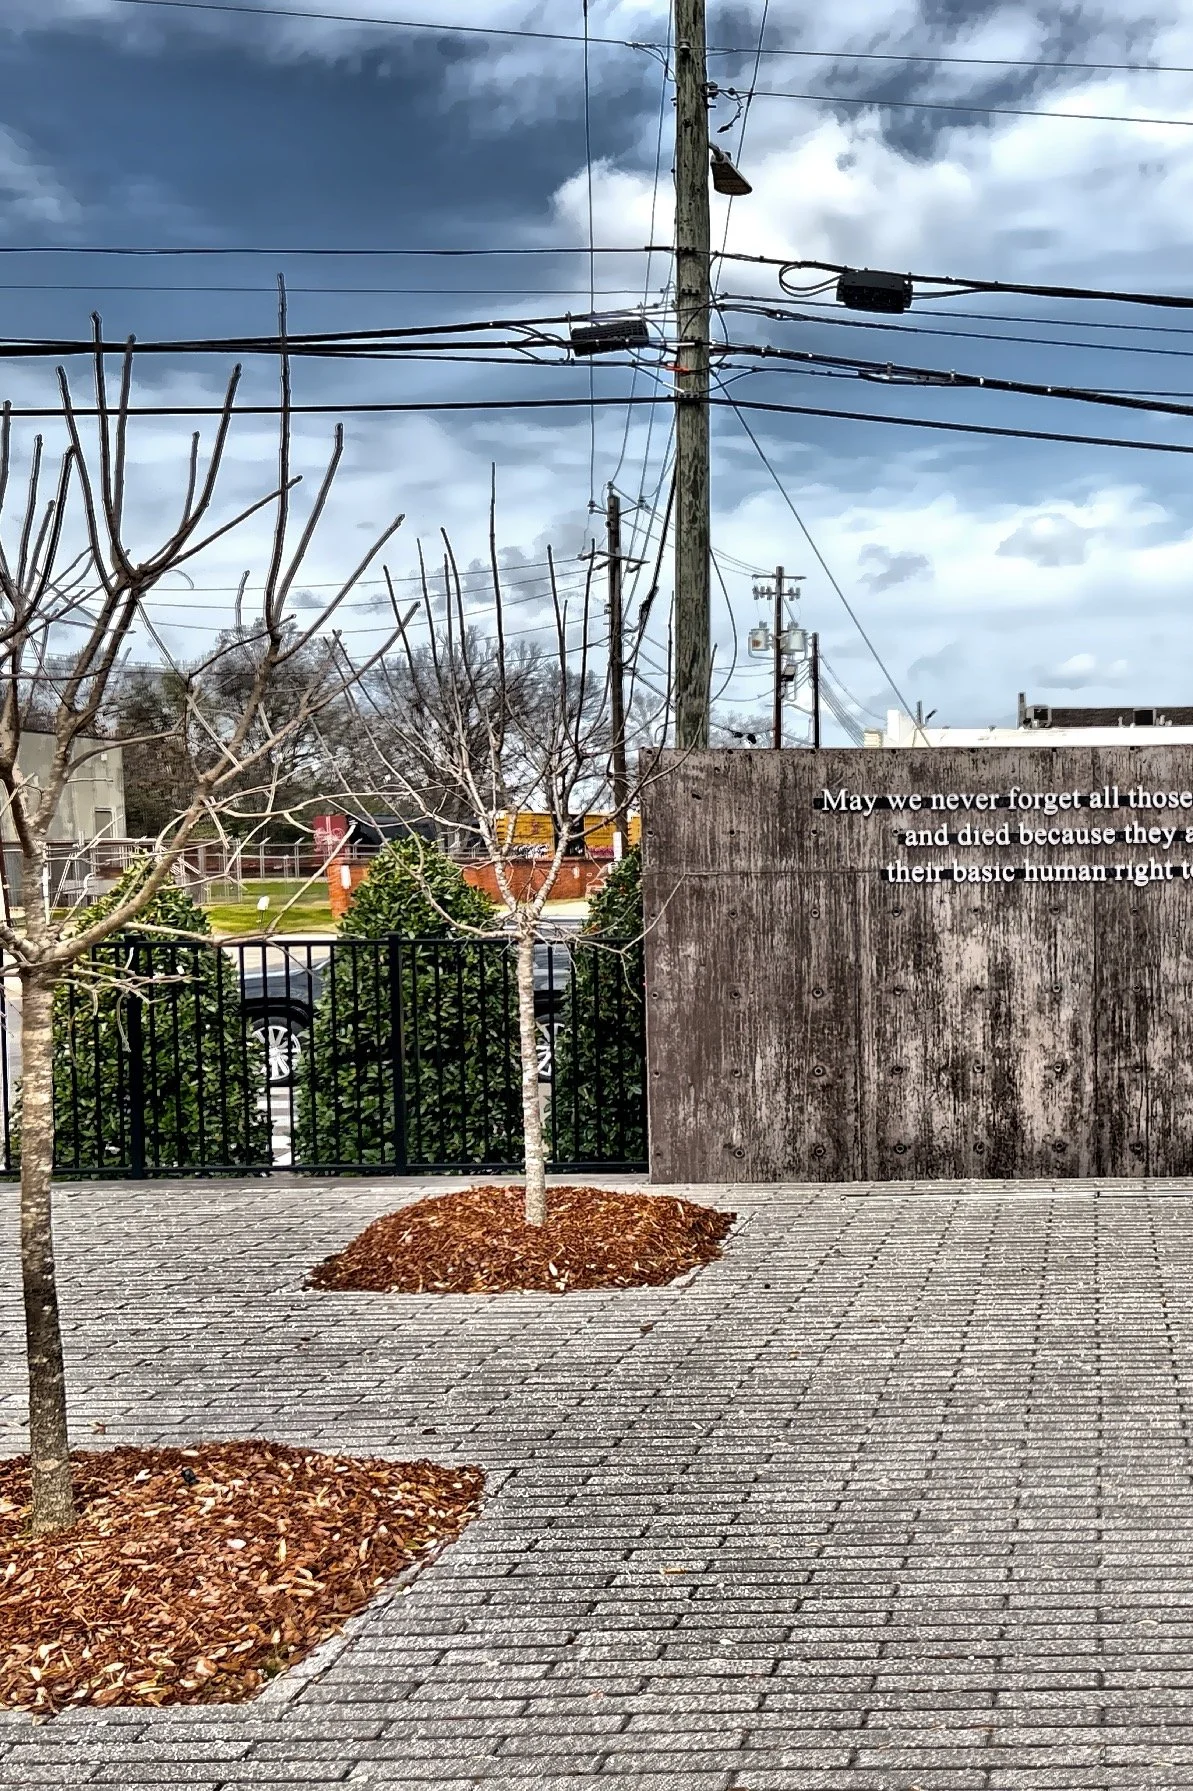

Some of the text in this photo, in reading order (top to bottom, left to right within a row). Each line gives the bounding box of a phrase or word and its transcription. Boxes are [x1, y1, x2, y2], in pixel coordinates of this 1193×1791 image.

[821, 788, 878, 817] May
[886, 793, 922, 810] we
[930, 793, 1000, 810] never
[1008, 785, 1081, 816] forget
[1089, 785, 1120, 809] all
[1127, 785, 1193, 809] those
[904, 823, 950, 846] and
[957, 822, 1011, 846] died
[1018, 821, 1116, 846] because
[1124, 820, 1177, 850] they
[886, 859, 944, 883] their
[952, 858, 1015, 883] basic
[1023, 858, 1107, 882] human
[1114, 857, 1174, 887] right
